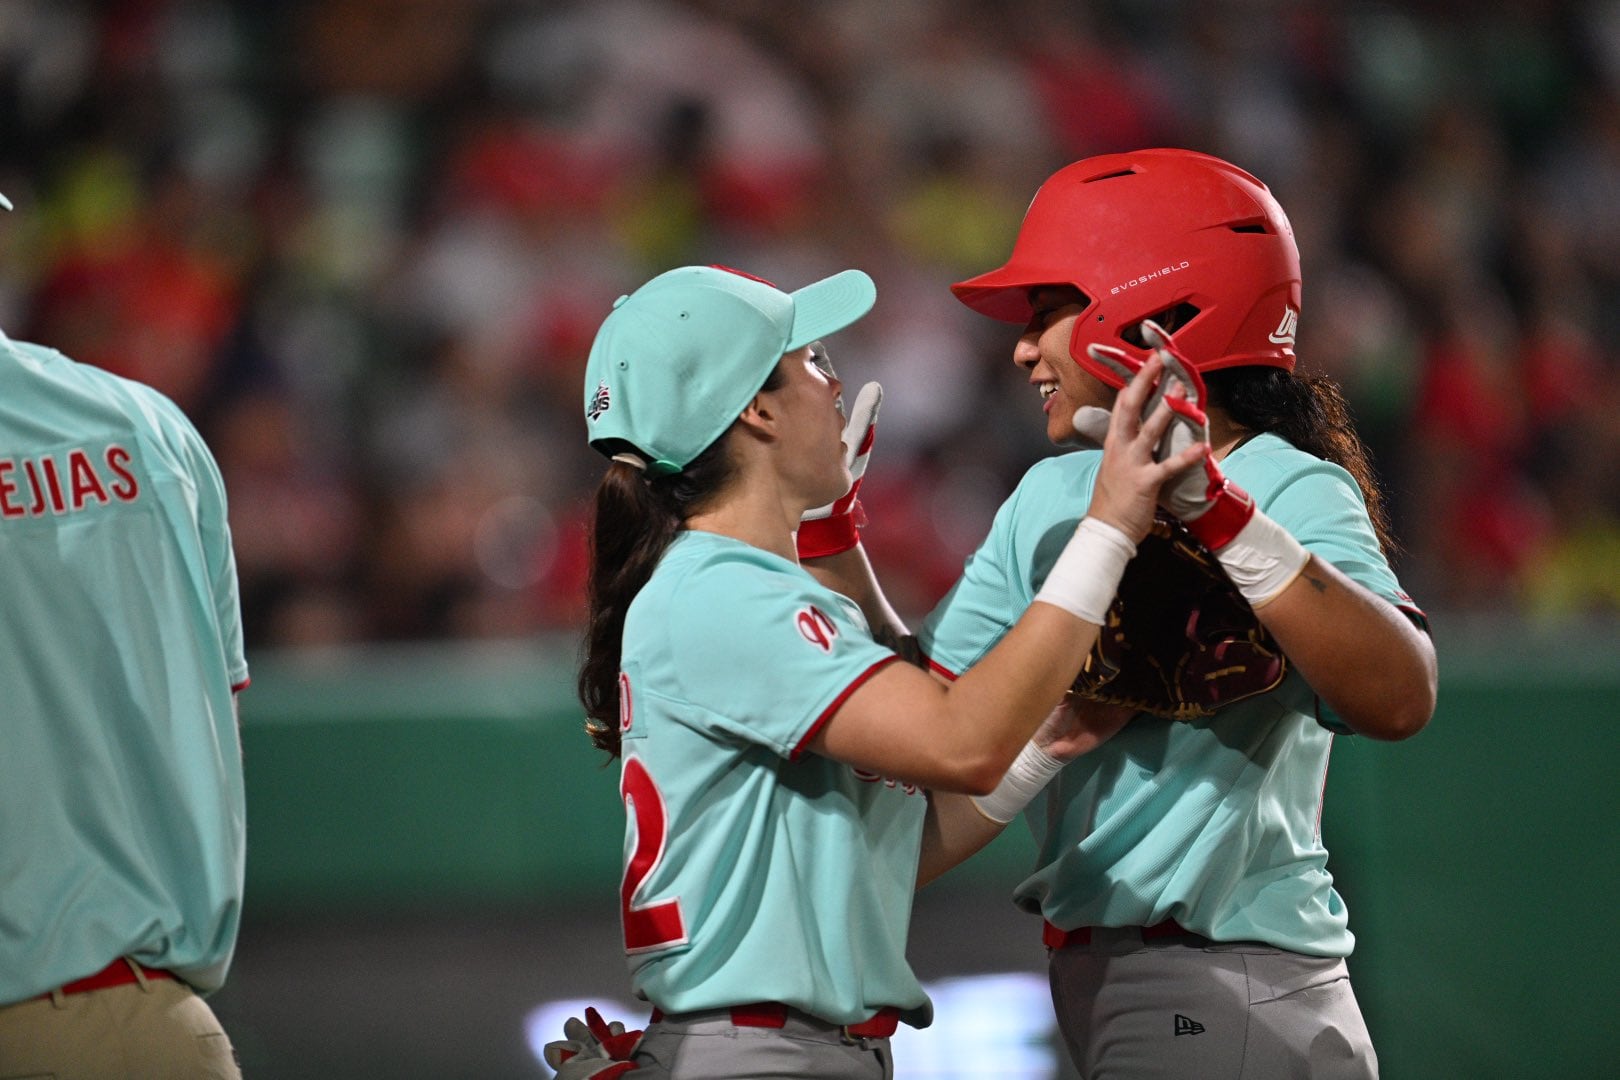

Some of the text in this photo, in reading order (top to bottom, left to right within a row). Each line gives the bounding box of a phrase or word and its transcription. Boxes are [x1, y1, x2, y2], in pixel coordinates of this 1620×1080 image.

[1111, 261, 1189, 295] EVOSHIELD
[0, 443, 139, 518] EJIAS
[620, 754, 689, 954] 2
